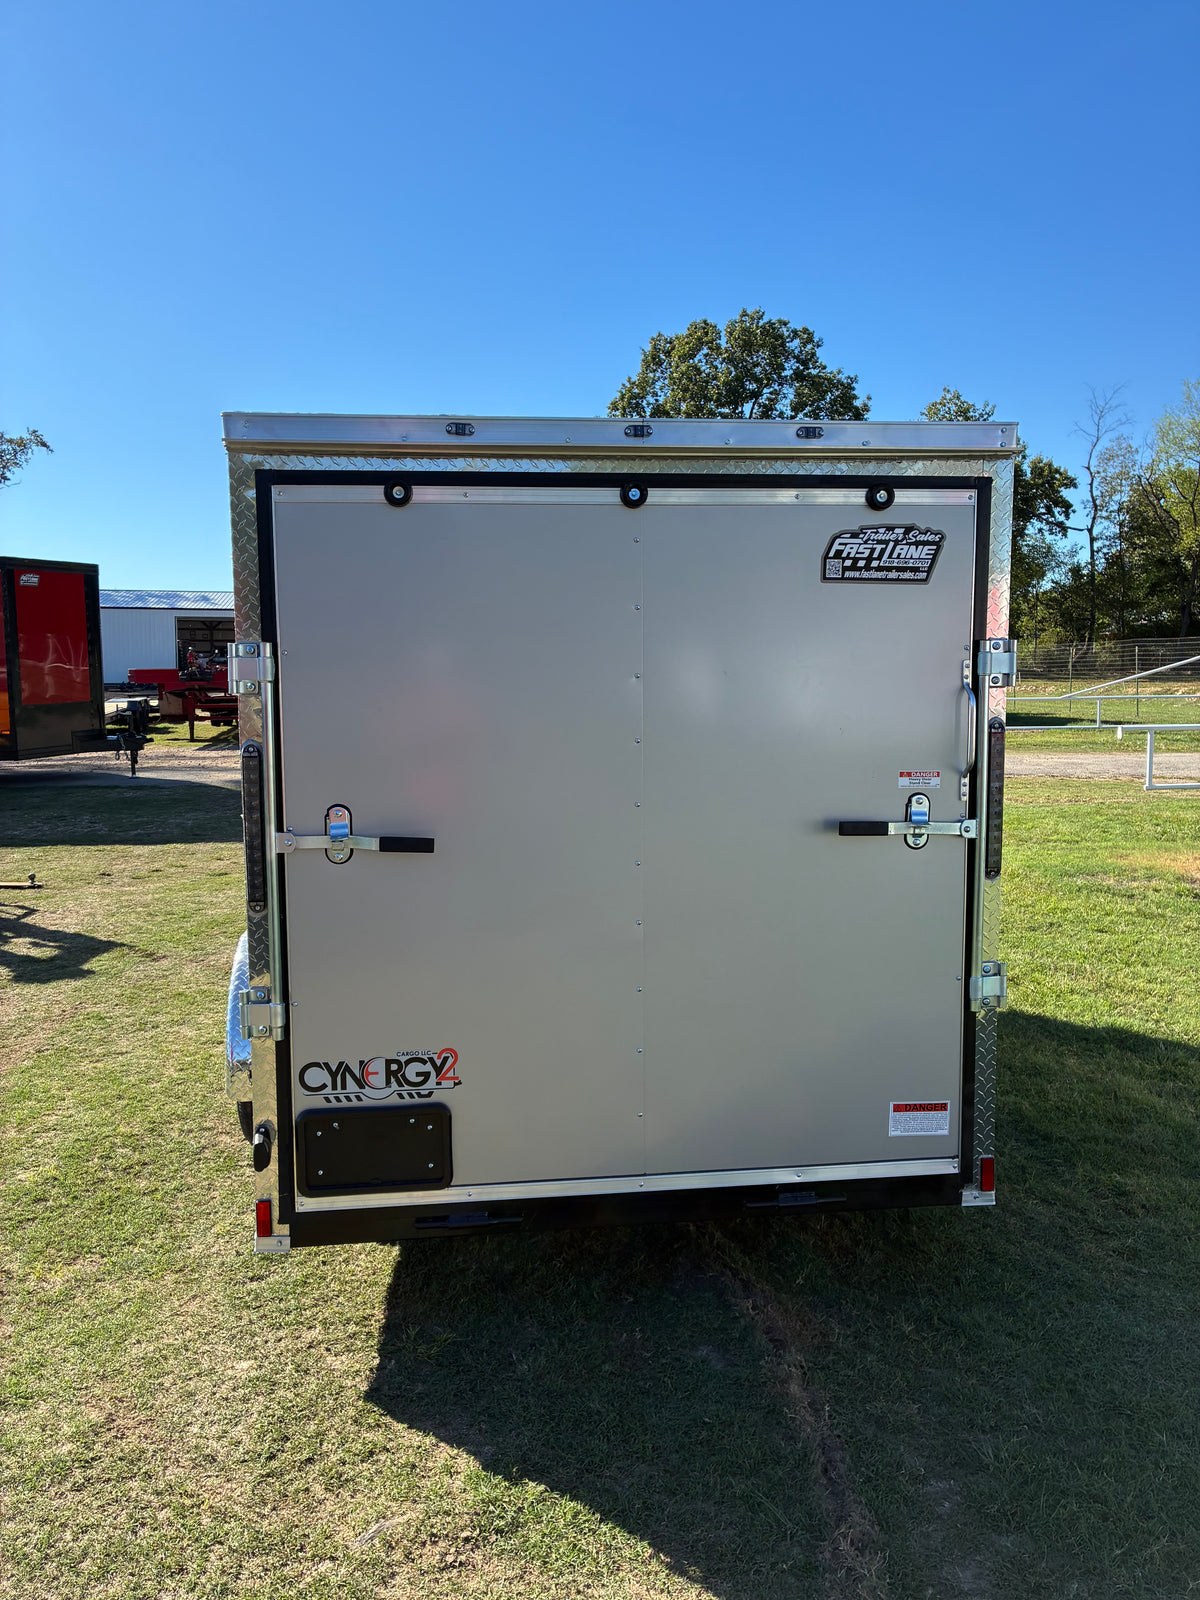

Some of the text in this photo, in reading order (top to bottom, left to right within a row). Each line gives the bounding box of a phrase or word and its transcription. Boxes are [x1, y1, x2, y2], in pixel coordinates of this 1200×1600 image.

[862, 528, 942, 542] Trailer Sales
[844, 569, 928, 579] www.fastlanetrailersales.com
[904, 1103, 947, 1112] DANGER
